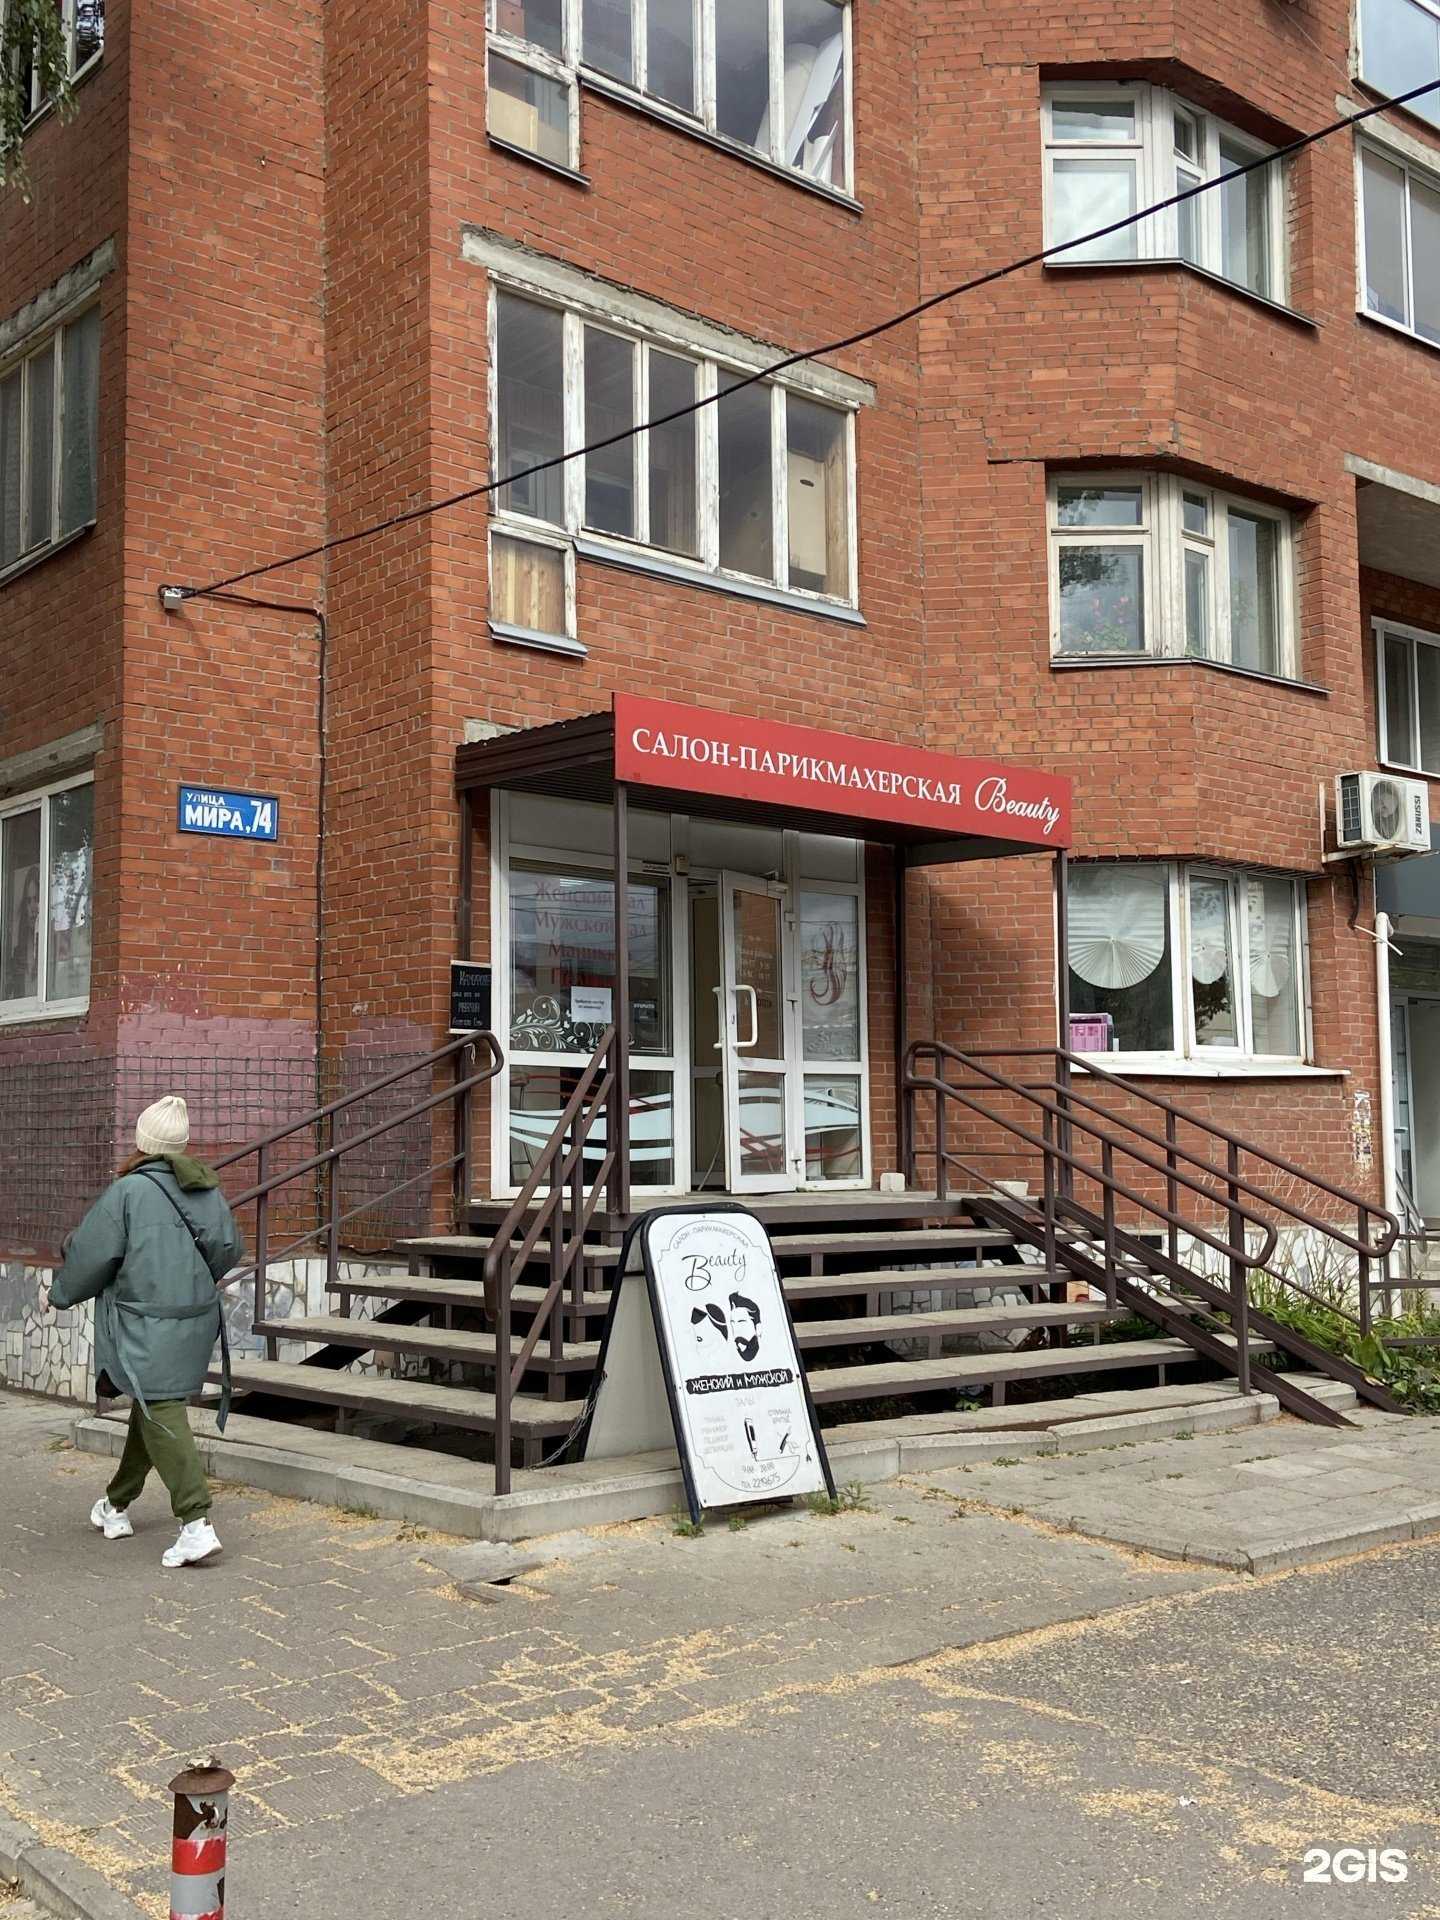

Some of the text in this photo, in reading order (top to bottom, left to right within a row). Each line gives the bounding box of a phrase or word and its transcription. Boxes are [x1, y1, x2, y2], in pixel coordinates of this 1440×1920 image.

[186, 793, 225, 806] УЛИЦА
[631, 728, 1060, 835] САЛОН-ПАРИКМАХЕРСКАЯ Beauty
[1414, 795, 1423, 834] ZANUSSI
[682, 1248, 747, 1291] Beauty
[692, 1375, 734, 1392] ЖЕНСКИЙ
